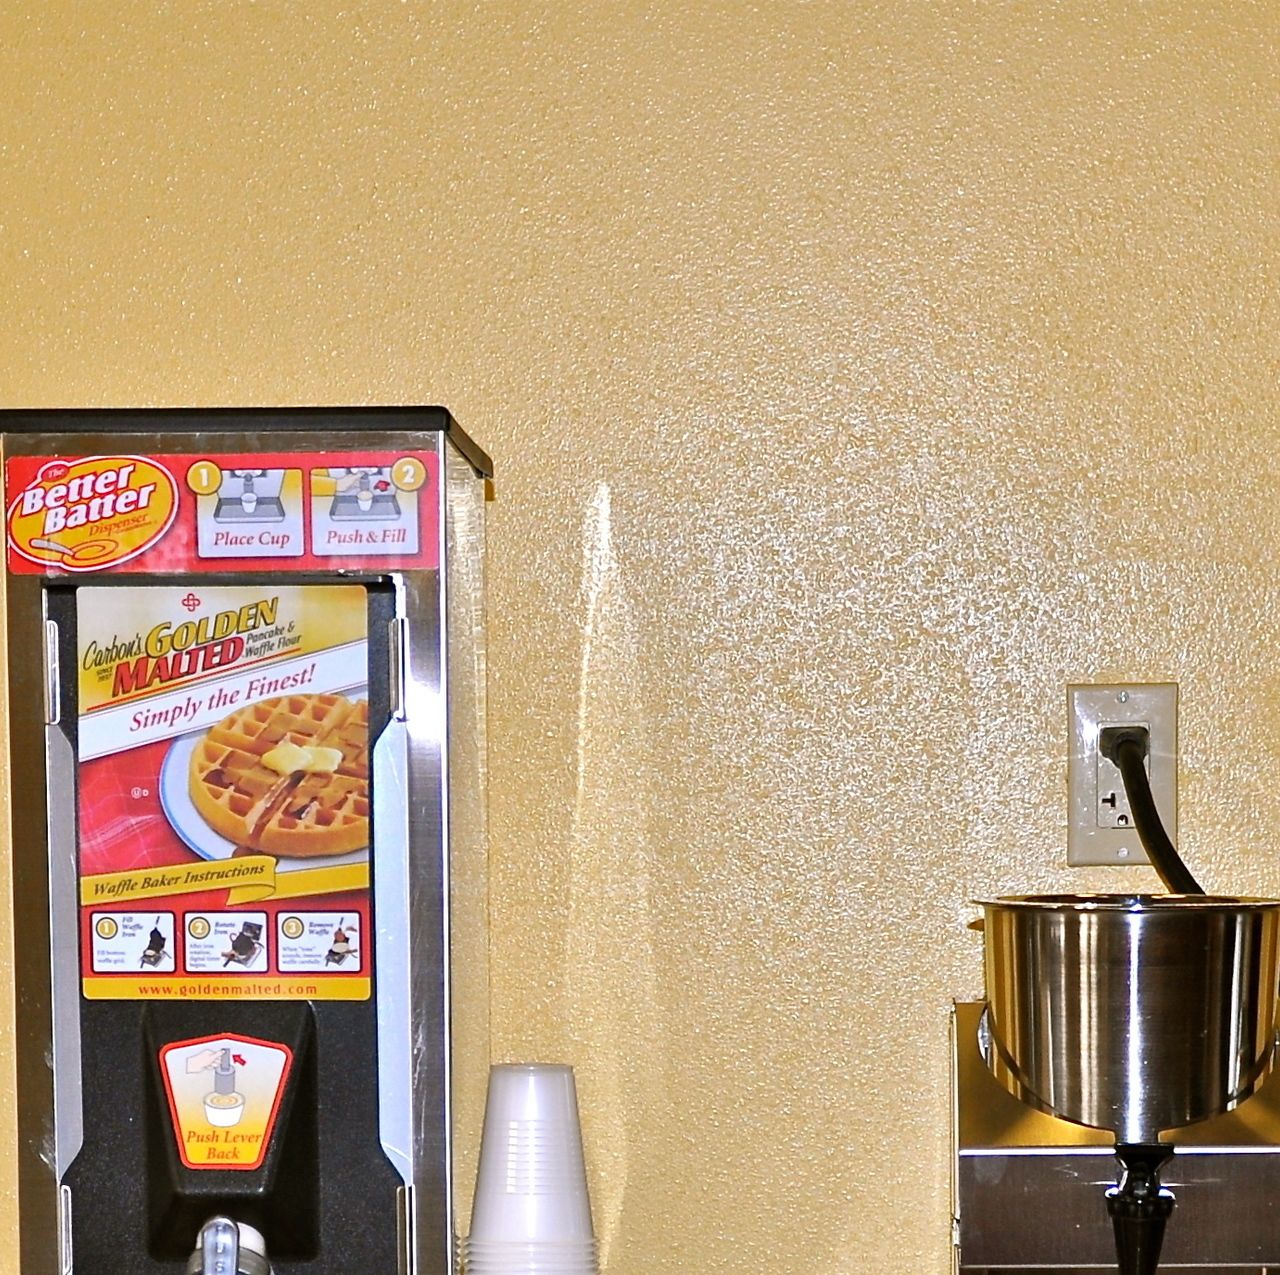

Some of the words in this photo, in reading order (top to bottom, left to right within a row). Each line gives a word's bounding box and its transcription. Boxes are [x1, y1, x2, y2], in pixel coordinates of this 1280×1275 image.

[48, 467, 64, 478] The
[200, 468, 209, 487] 1
[402, 465, 415, 484] 2
[21, 463, 136, 516] Better
[42, 483, 156, 536] Batter
[89, 514, 148, 536] Dispenser
[327, 530, 363, 544] Push
[366, 530, 378, 543] &
[381, 528, 407, 543] Fill
[214, 531, 255, 546] Place
[259, 531, 290, 548] Cup
[83, 633, 142, 671] Carbon's
[145, 597, 279, 658] GOLDEN
[246, 626, 285, 644] Pancake
[287, 620, 295, 633] &
[246, 641, 275, 657] Waffle
[278, 634, 302, 649] Flour
[112, 636, 245, 698] MALTED
[130, 697, 203, 732] Simply
[208, 689, 240, 711] the
[245, 663, 316, 697] Finest!
[94, 879, 138, 897] Waffle
[141, 874, 181, 890] Baker
[184, 864, 265, 884] Instructions
[139, 984, 317, 996] www.goldenmalted.com
[186, 1130, 219, 1143] Push
[224, 1131, 262, 1143] Lever
[207, 1147, 240, 1160] Back
